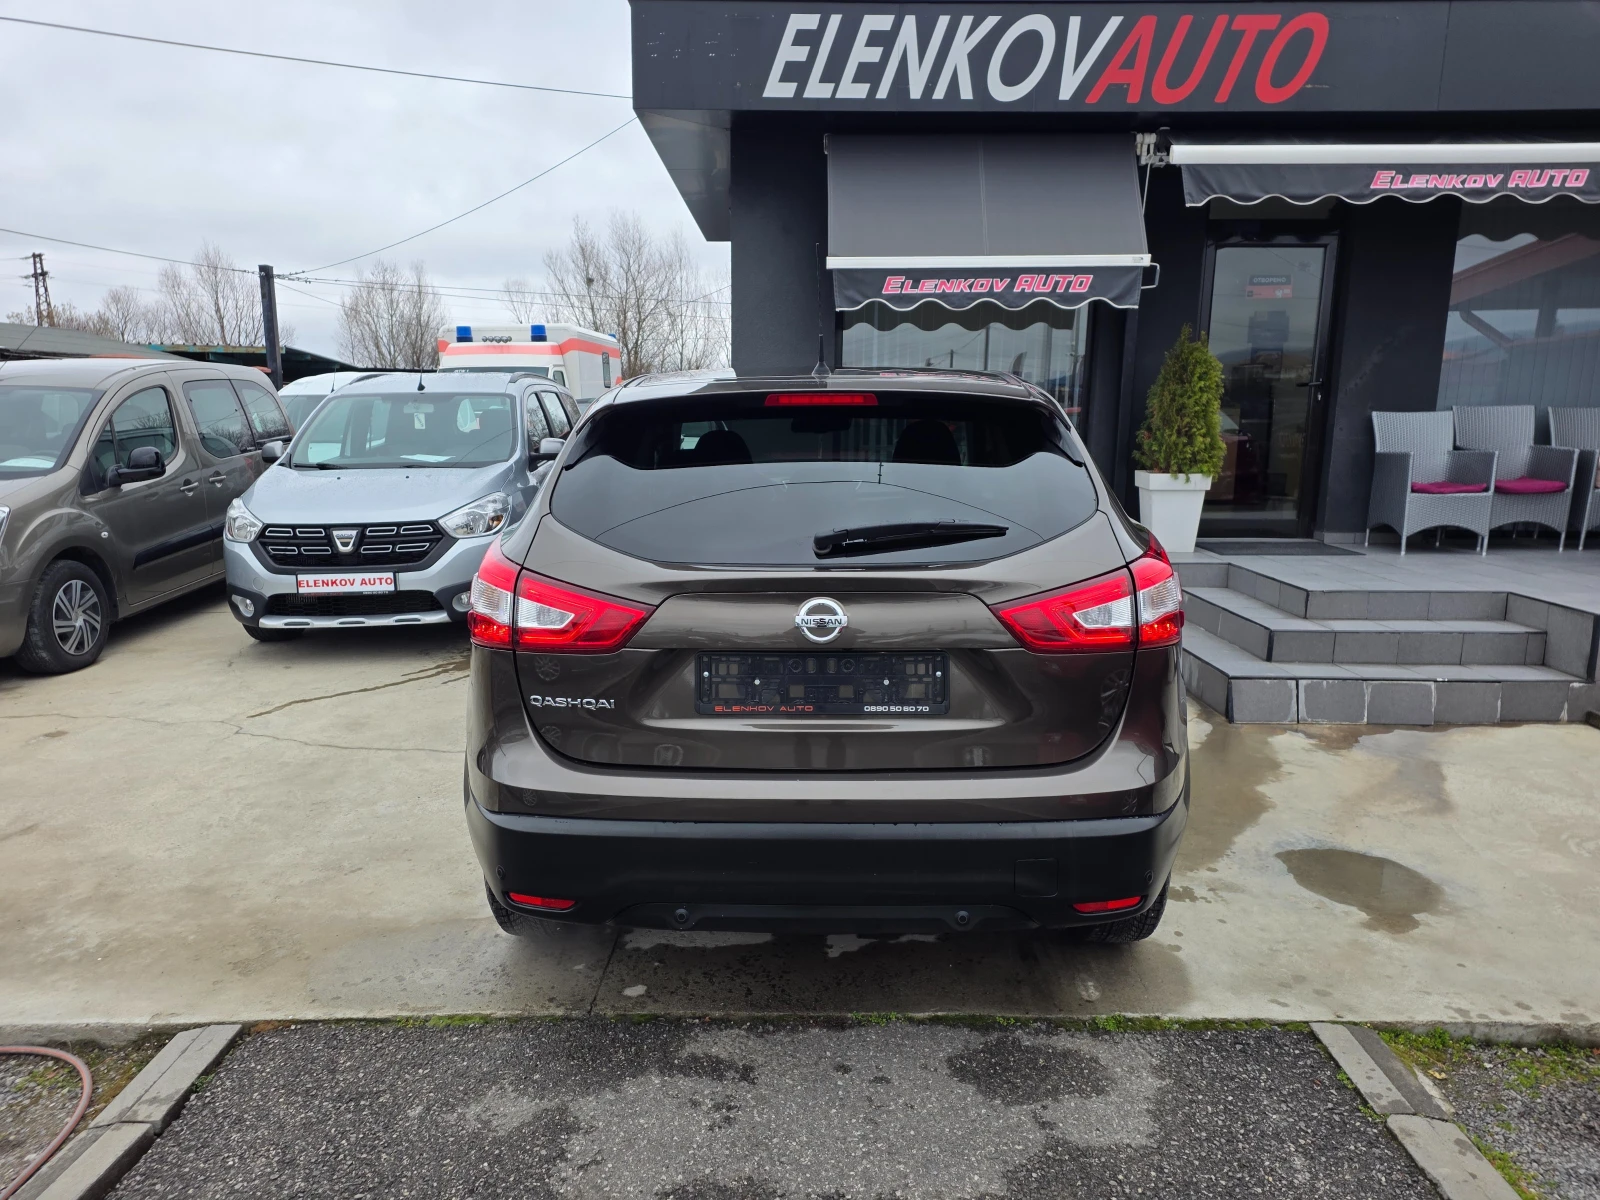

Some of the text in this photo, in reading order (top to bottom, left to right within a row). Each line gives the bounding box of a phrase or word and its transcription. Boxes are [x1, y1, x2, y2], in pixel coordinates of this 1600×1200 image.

[1370, 169, 1590, 189] ELENKOV AUTO
[882, 274, 1094, 294] ELENKOV AUTO
[298, 577, 393, 588] ELENKOV AUTO
[529, 695, 615, 711] QASHQAI
